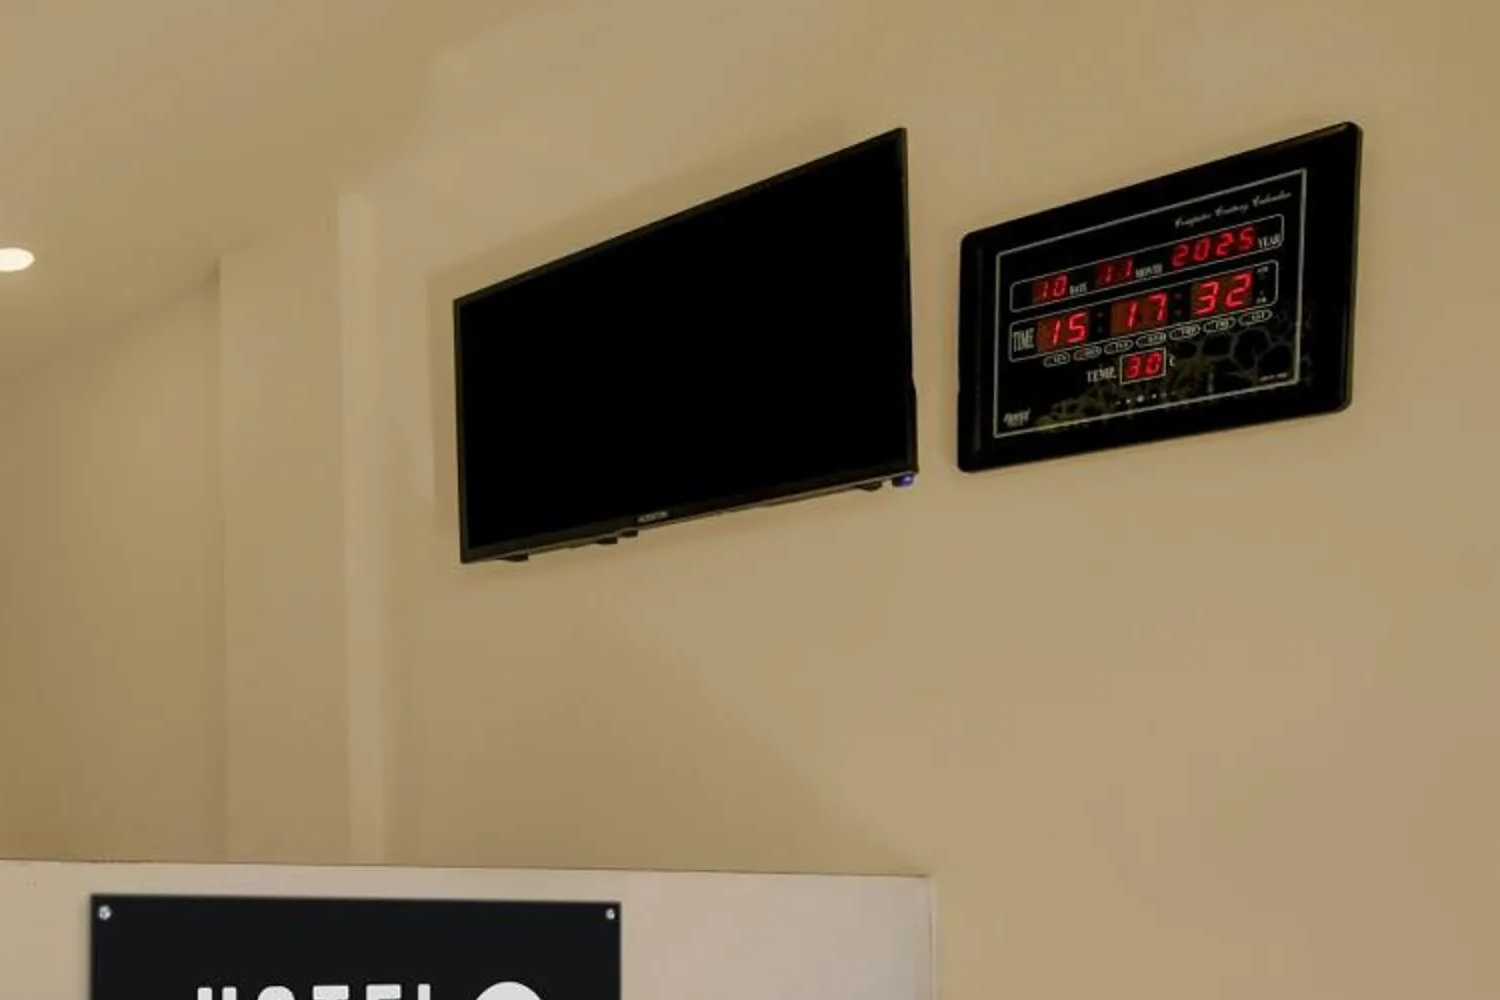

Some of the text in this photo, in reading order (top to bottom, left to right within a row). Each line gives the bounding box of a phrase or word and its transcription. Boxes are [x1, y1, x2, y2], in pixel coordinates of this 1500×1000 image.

[1171, 224, 1256, 268] 2025
[1012, 327, 1035, 353] TIME
[1051, 310, 1088, 346] 15
[1125, 290, 1168, 330] 17
[1195, 271, 1253, 316] 32
[1124, 353, 1162, 379] 30
